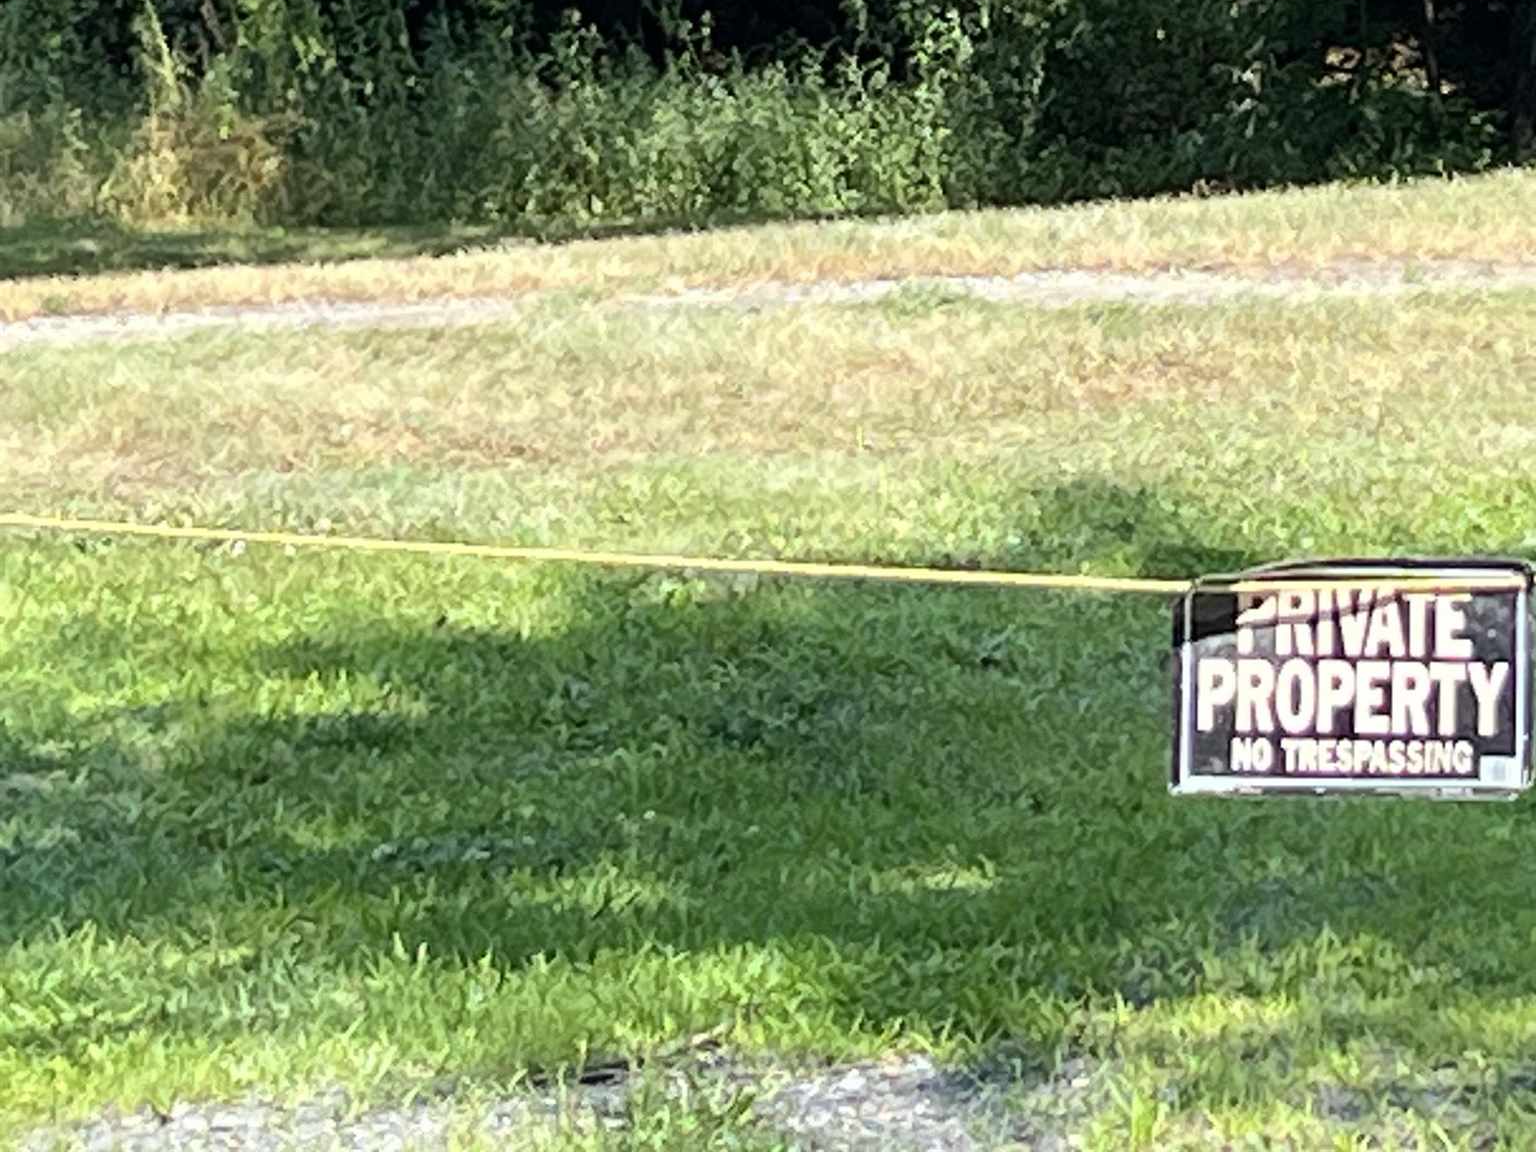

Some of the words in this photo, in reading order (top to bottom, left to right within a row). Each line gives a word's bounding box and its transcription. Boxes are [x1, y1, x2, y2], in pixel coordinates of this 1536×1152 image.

[1236, 588, 1474, 657] PRIVATE
[1196, 658, 1510, 737] PROPERTY
[1230, 737, 1273, 772] NO
[1280, 737, 1474, 774] TRESPASSING
